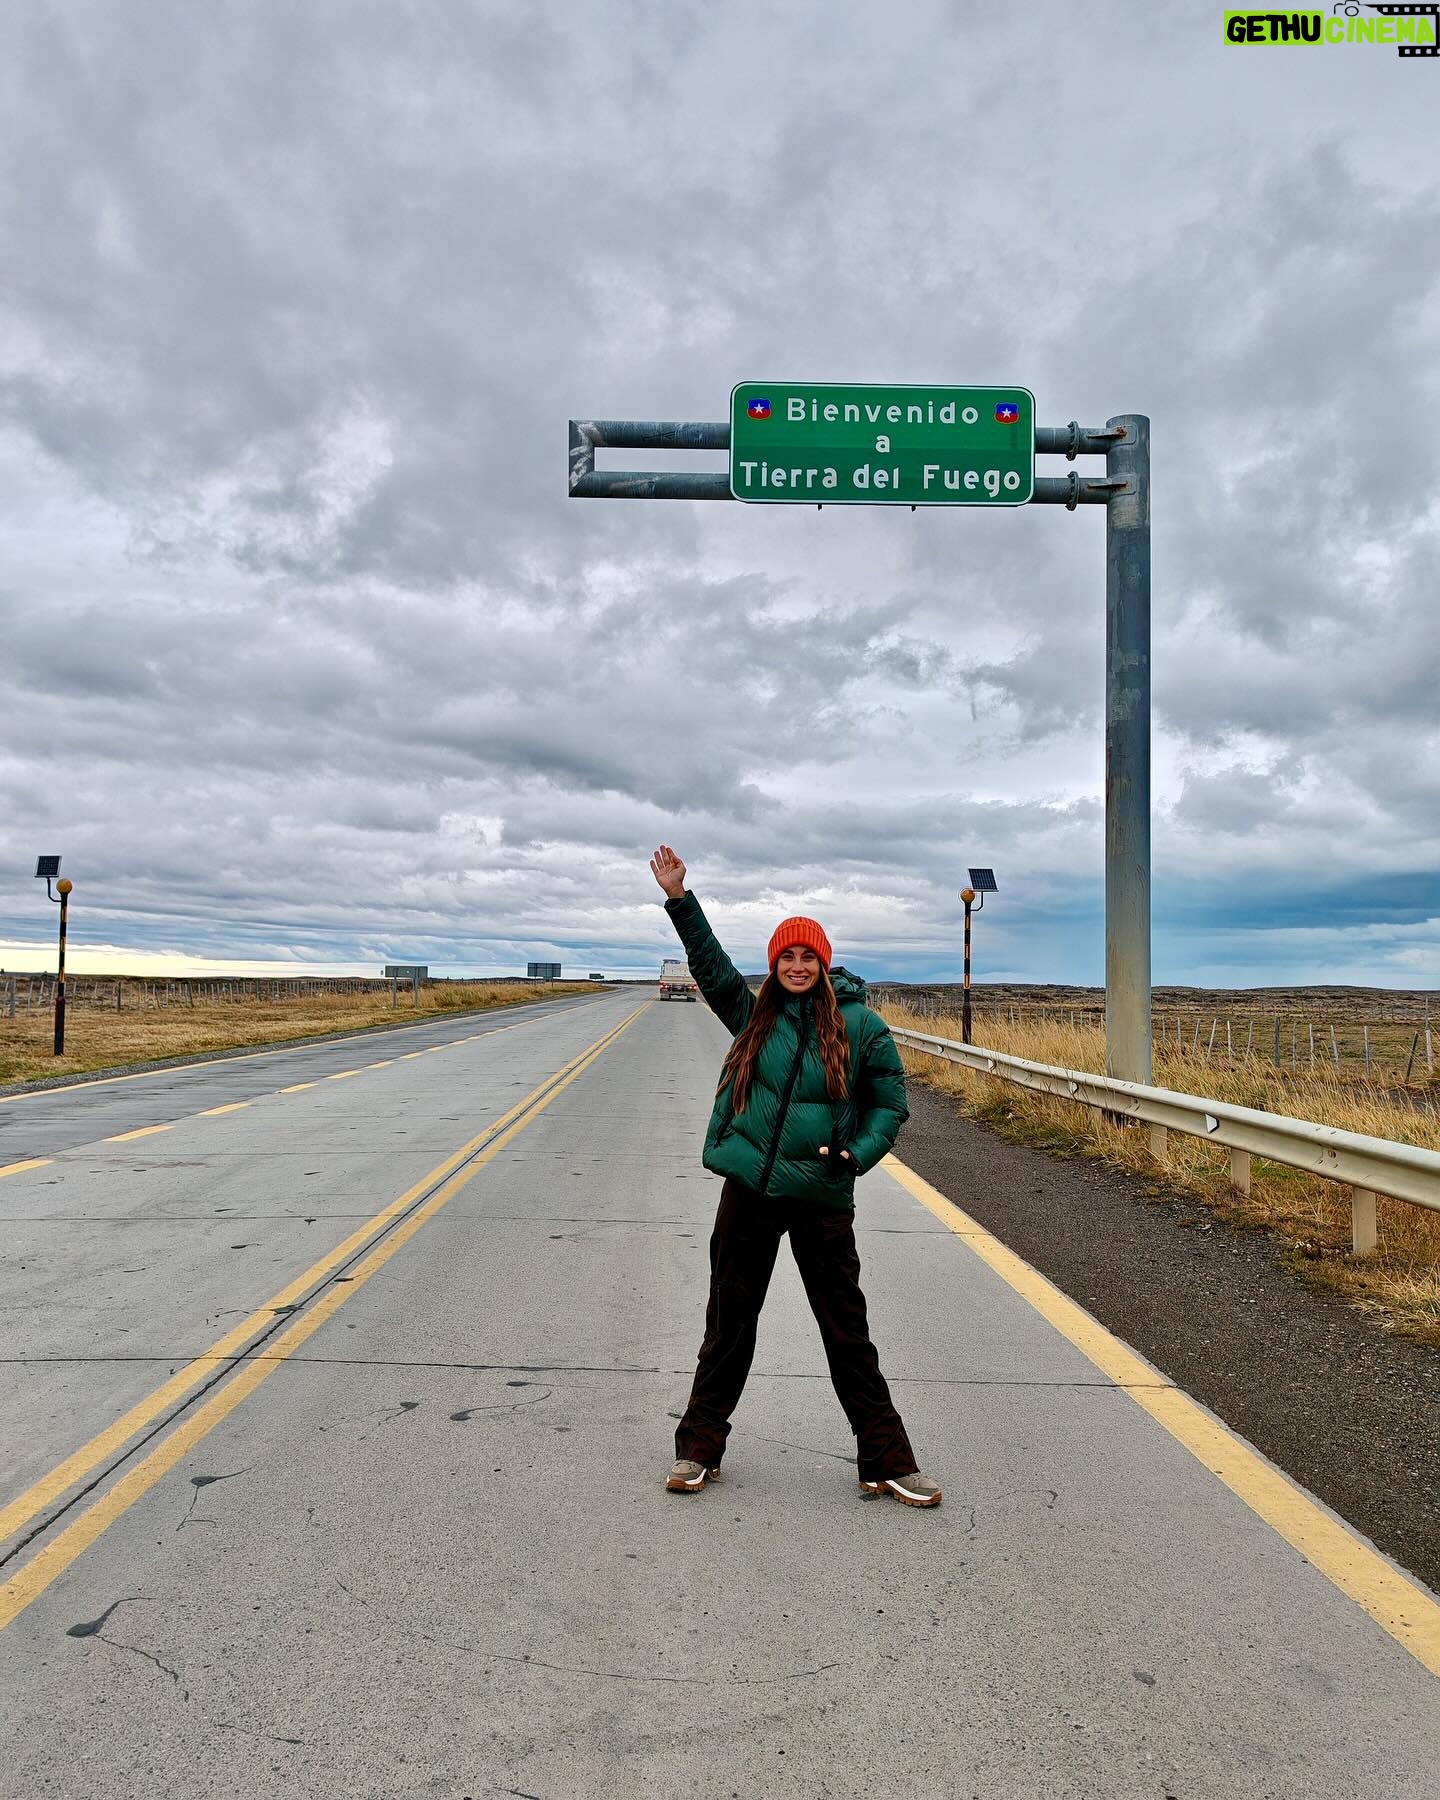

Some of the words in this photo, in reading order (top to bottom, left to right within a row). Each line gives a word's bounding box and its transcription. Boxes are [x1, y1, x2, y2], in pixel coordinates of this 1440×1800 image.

[786, 397, 979, 424] Bienvenido
[875, 434, 890, 453] a
[739, 461, 838, 489] Tierra
[852, 463, 899, 489] del
[923, 464, 1021, 498] Fuego
